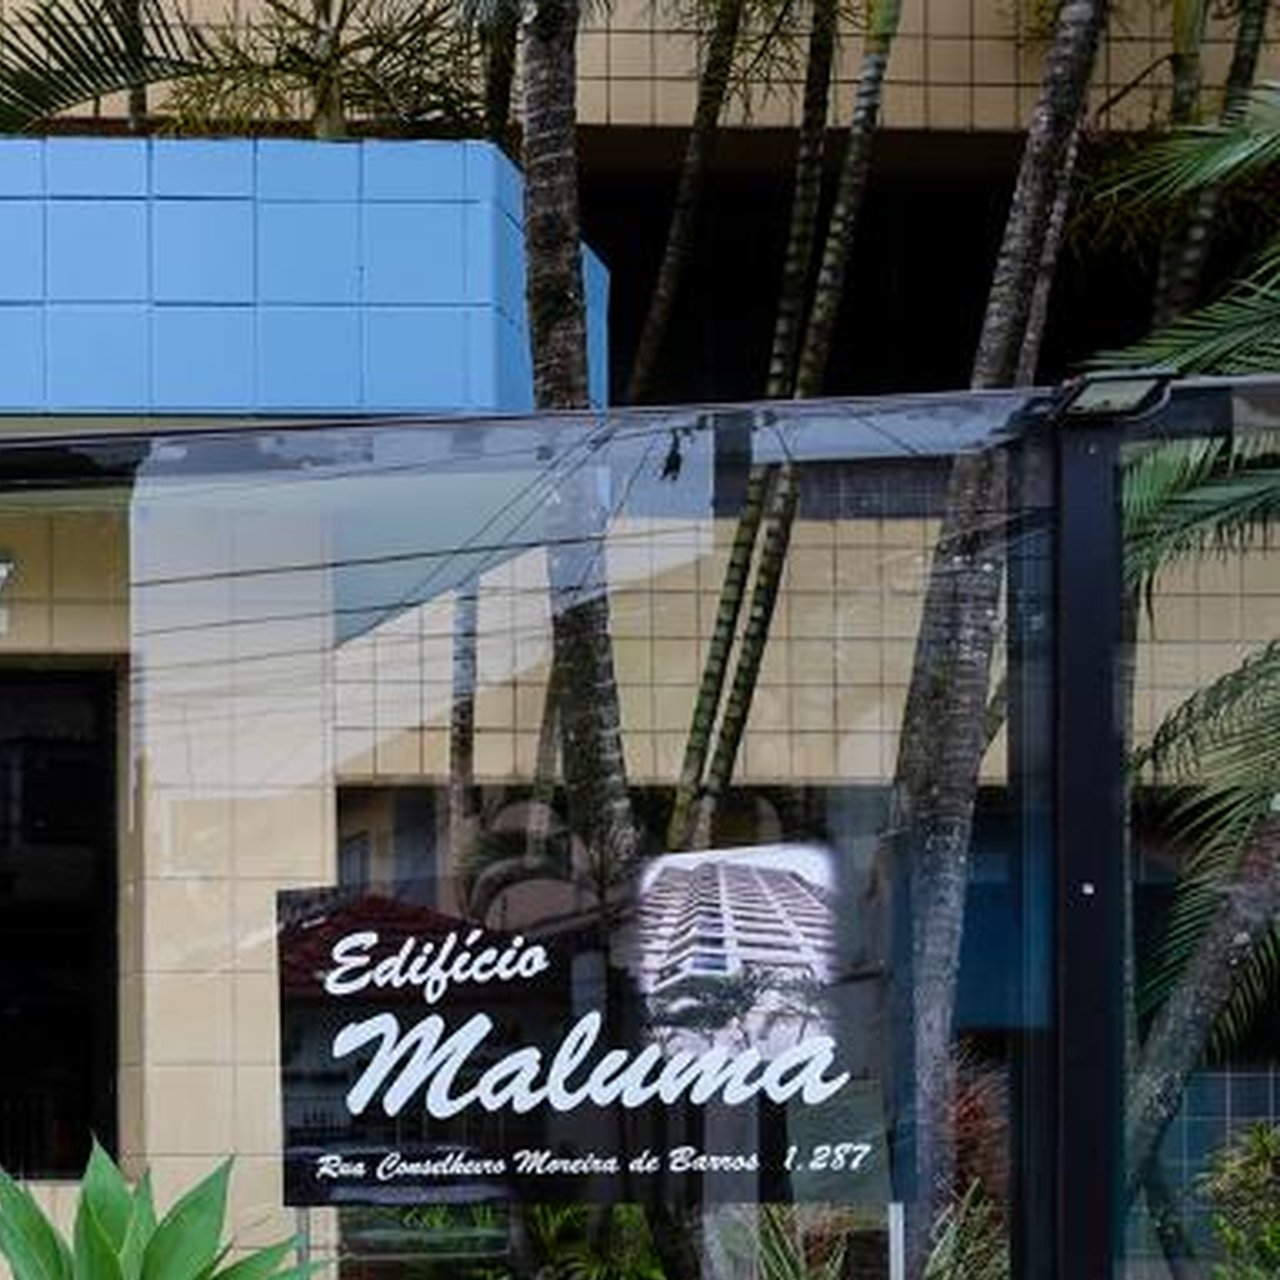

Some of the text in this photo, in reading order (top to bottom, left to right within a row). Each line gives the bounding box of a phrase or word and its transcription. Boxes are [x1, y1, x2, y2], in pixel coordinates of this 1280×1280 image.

[324, 928, 550, 1004] Edifício
[332, 1010, 851, 1121] Maluma
[315, 1155, 367, 1180] Rua
[376, 1151, 507, 1181] Conselheiro
[512, 1149, 621, 1174] Moreira
[628, 1149, 661, 1173] de
[668, 1145, 761, 1173] Barros
